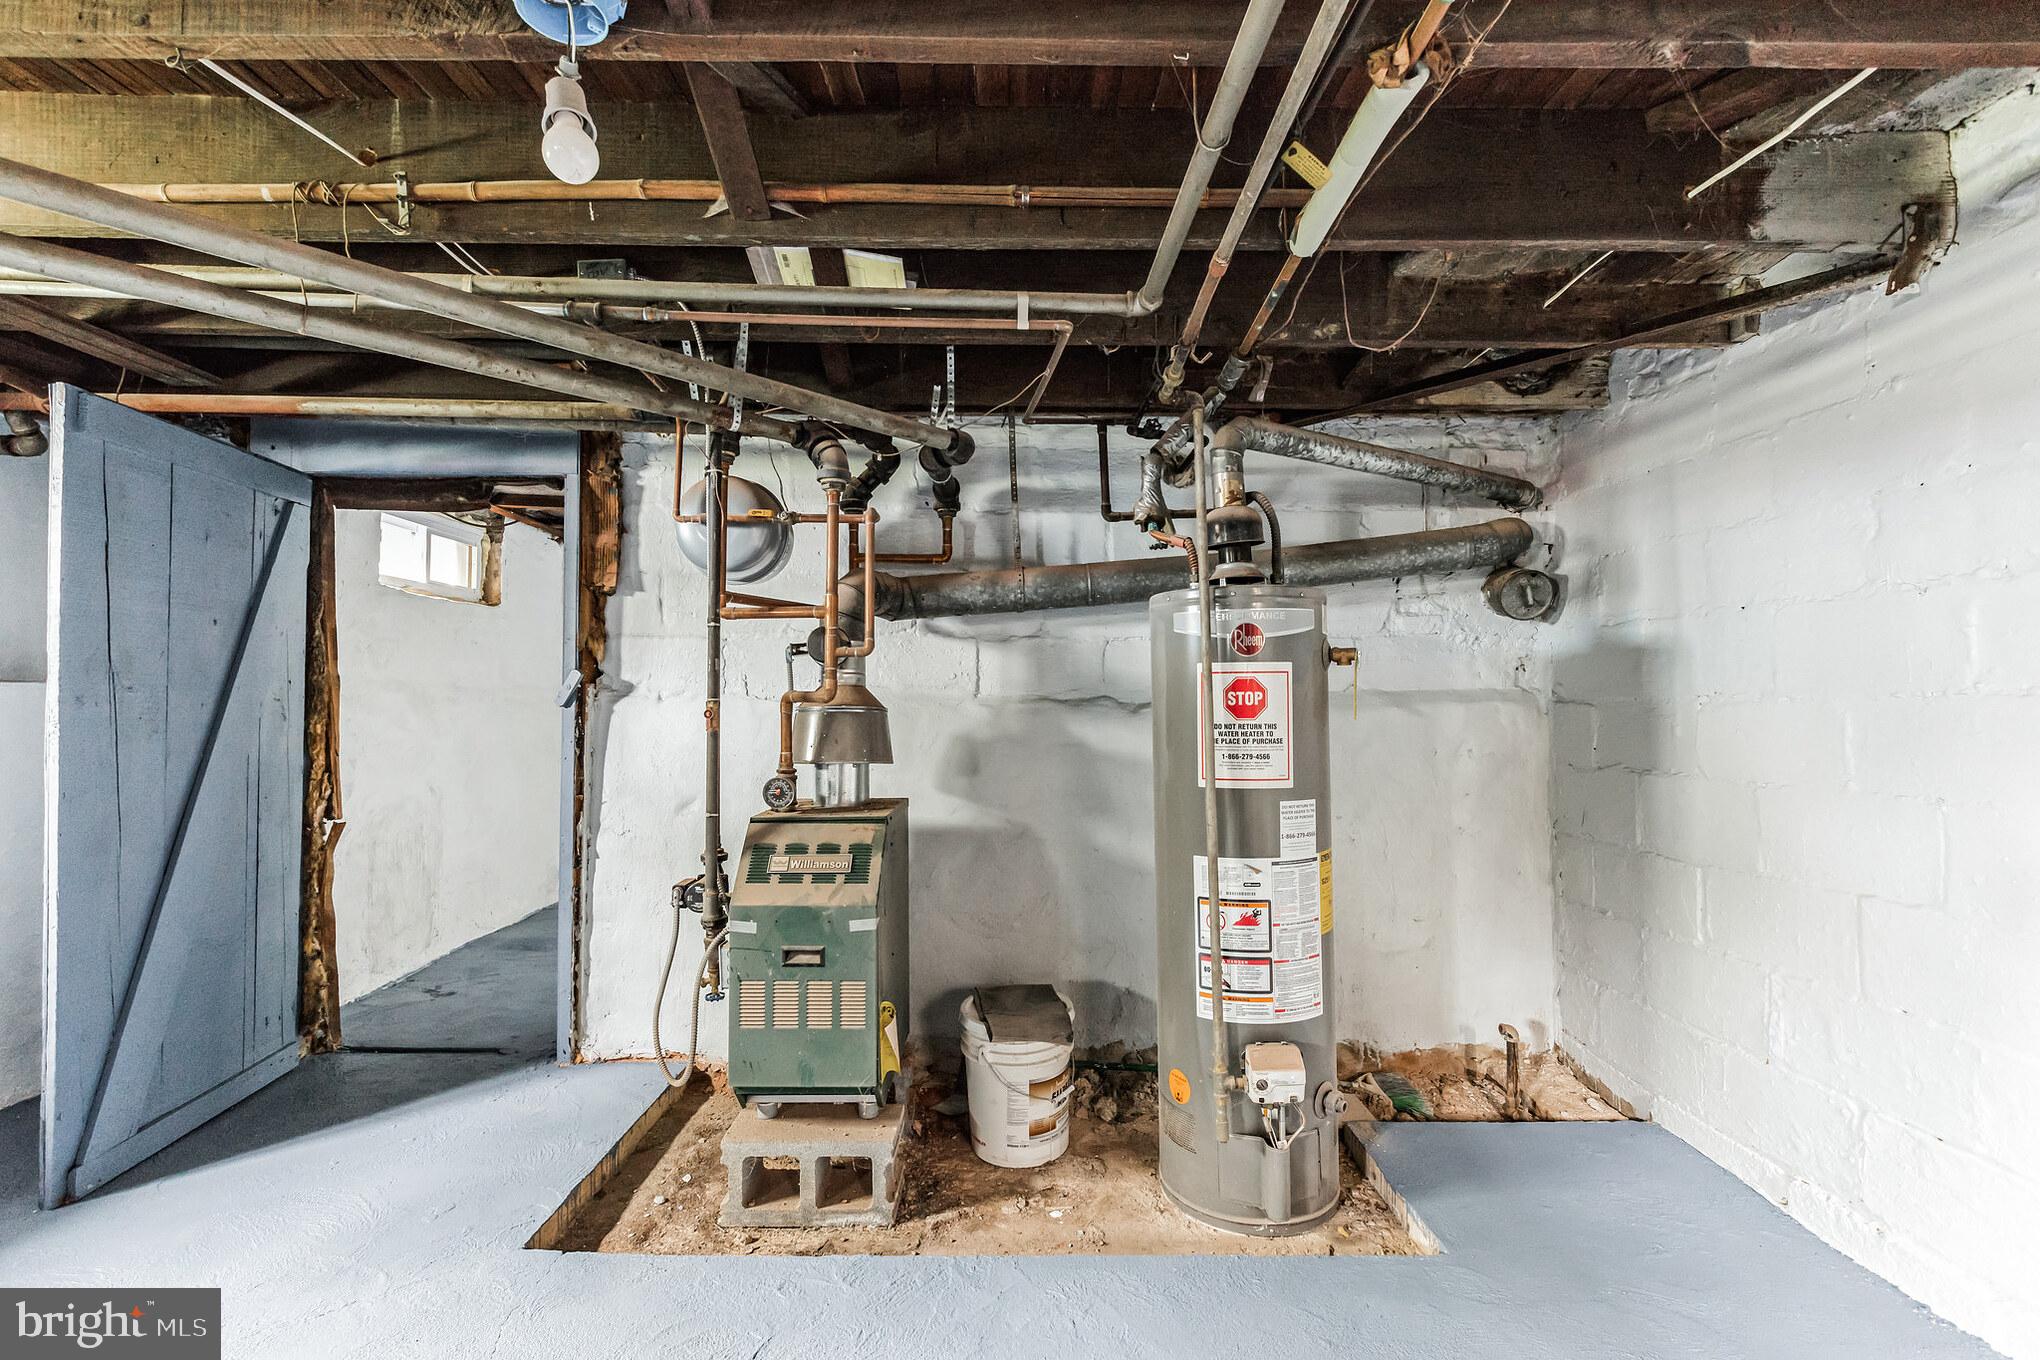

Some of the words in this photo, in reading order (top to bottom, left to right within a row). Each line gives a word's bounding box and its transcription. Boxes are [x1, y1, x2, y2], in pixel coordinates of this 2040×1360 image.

[1234, 623, 1263, 651] Rheem
[1227, 691, 1263, 706] STOP
[791, 860, 849, 869] Williamson
